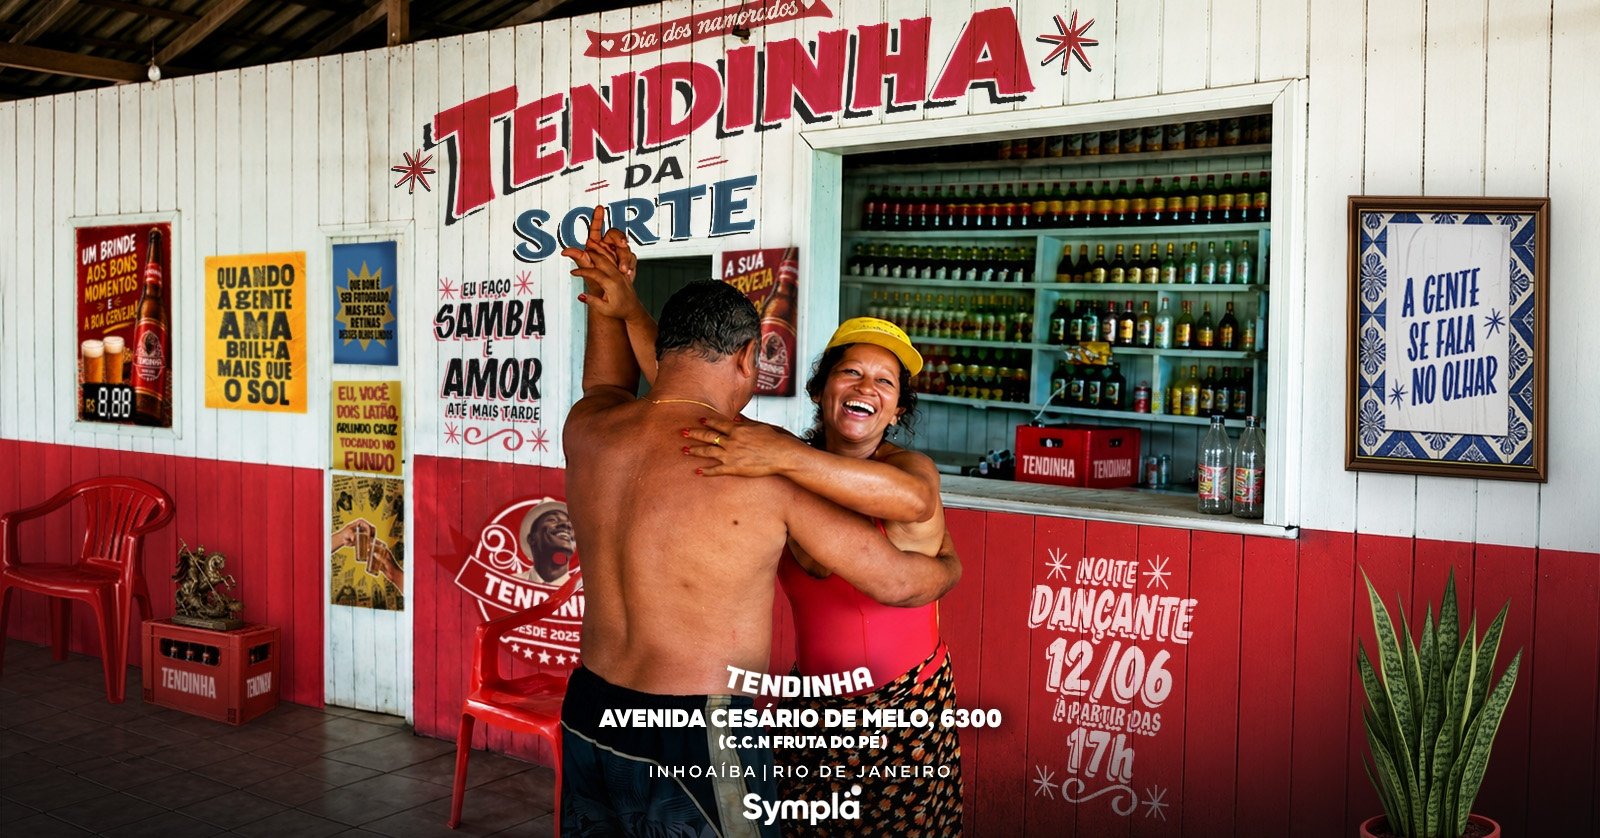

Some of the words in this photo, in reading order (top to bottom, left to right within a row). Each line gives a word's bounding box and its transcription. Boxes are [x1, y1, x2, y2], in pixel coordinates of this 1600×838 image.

[620, 31, 658, 53] Dia
[663, 22, 691, 43] dos
[697, 1, 798, 34] namorados
[424, 7, 1035, 225] TENDINHA
[624, 156, 683, 189] DA
[513, 175, 757, 262] SORTE
[82, 244, 97, 265] UM
[100, 234, 136, 259] BRINDE
[87, 263, 106, 284] AOS
[110, 253, 137, 276] BONS
[217, 264, 295, 289] QUANDO
[725, 260, 734, 278] A
[738, 252, 764, 274] SUA
[85, 275, 138, 303] MOMENTOS
[341, 292, 352, 303] SER
[350, 279, 361, 291] QUE
[461, 281, 476, 299] EU
[479, 279, 511, 299] FAÇO
[1402, 278, 1414, 317] A
[1423, 267, 1480, 315] GENTE
[107, 299, 113, 310] E
[218, 290, 231, 309] A
[345, 305, 361, 316] MAS
[363, 305, 386, 316] PELAS
[84, 316, 90, 331] A
[91, 312, 104, 327] BOA
[105, 300, 138, 326] CERVEJA!
[218, 311, 292, 340] AMA
[351, 317, 380, 328] RETINAS
[434, 299, 546, 341] SAMBA
[226, 340, 290, 360] BRILHA
[483, 339, 493, 357] E
[1407, 322, 1429, 361] SE
[1436, 314, 1475, 358] FALA
[217, 359, 261, 378] MAIS
[266, 361, 292, 380] QUE
[441, 357, 542, 402] AMOR
[1412, 366, 1436, 406] NO
[1442, 355, 1497, 400] OLHAR
[86, 399, 95, 413] R$
[98, 387, 132, 420] 8,88
[224, 379, 242, 402] O
[247, 379, 290, 405] SOL
[338, 386, 357, 402] EU,
[359, 382, 390, 401] VOCÊ
[337, 405, 360, 419] DOIS
[363, 403, 398, 422] LATÃO,
[445, 401, 467, 419] ATÉ
[470, 404, 498, 421] MAIS
[501, 405, 540, 422] TARDE
[337, 423, 371, 434] ARLINDO
[373, 424, 397, 436] CRUZ
[340, 437, 380, 449] TOCANDO
[383, 440, 396, 450] NO
[344, 451, 395, 473] FUNDO
[1023, 455, 1075, 478] TENDINHA
[1093, 459, 1131, 478] TENDINHA
[1076, 557, 1139, 588] NOITE
[1028, 585, 1198, 644] DANÇANTE
[512, 625, 547, 638] ESDE
[550, 630, 579, 642] 2025
[161, 667, 216, 699] TENDINHA
[247, 672, 271, 698] TENDINHA
[1046, 637, 1172, 708] 12/06
[1052, 695, 1065, 722] À
[1067, 702, 1124, 731] PARTIR
[1127, 709, 1161, 736] DAS
[1067, 728, 1134, 784] 17h
